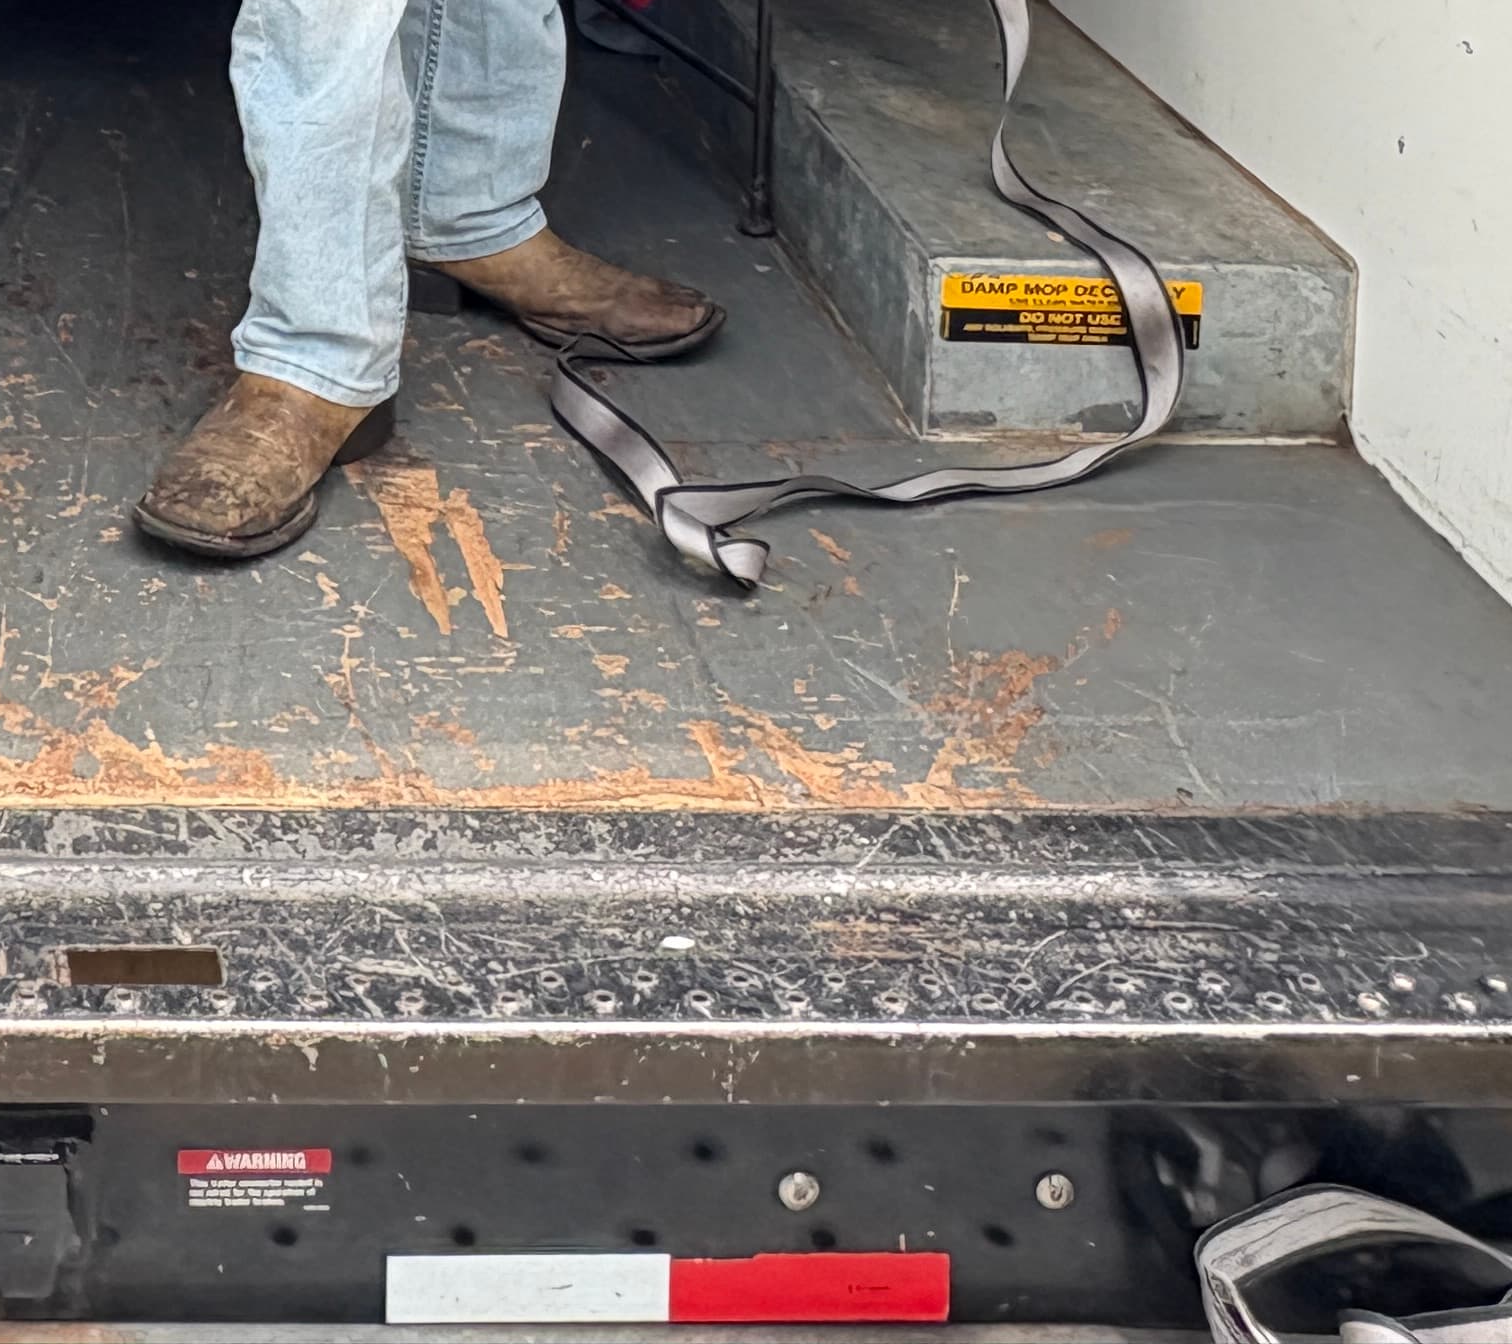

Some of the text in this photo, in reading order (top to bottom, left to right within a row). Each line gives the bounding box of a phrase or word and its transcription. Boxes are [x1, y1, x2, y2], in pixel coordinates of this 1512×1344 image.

[961, 281, 1018, 295] DAMP
[1024, 284, 1068, 297] MOP
[1019, 311, 1122, 326] DO NOT USE
[224, 1152, 306, 1170] WARNING
